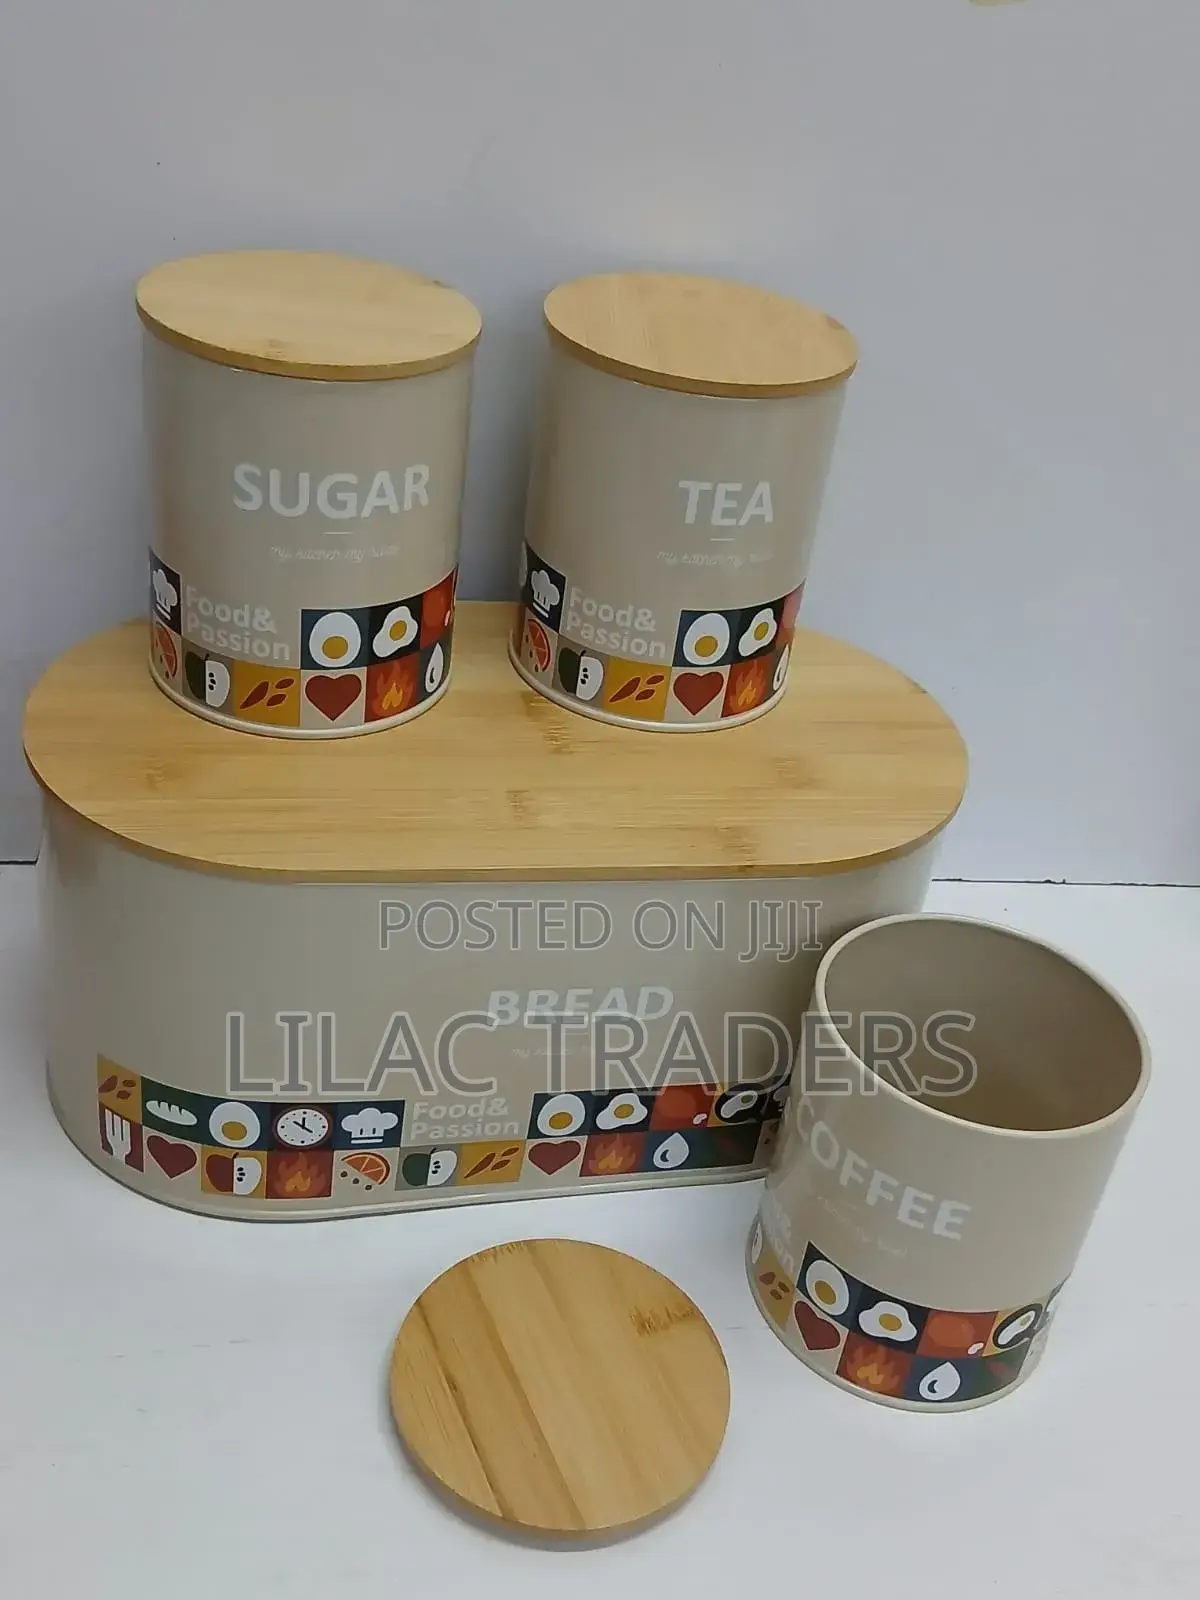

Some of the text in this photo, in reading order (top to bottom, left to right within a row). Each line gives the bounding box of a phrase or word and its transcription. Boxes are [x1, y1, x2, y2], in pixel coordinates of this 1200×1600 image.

[233, 462, 430, 520] SUGAR
[678, 480, 774, 527] TEA
[185, 584, 278, 634] Food&
[569, 586, 657, 633] Food&
[186, 612, 291, 661] Passion
[566, 614, 667, 659] Passion
[487, 985, 674, 1027] BREAD
[410, 1118, 520, 1141] Passion
[413, 1097, 509, 1121] Food&
[797, 1095, 972, 1240] COFFEE
